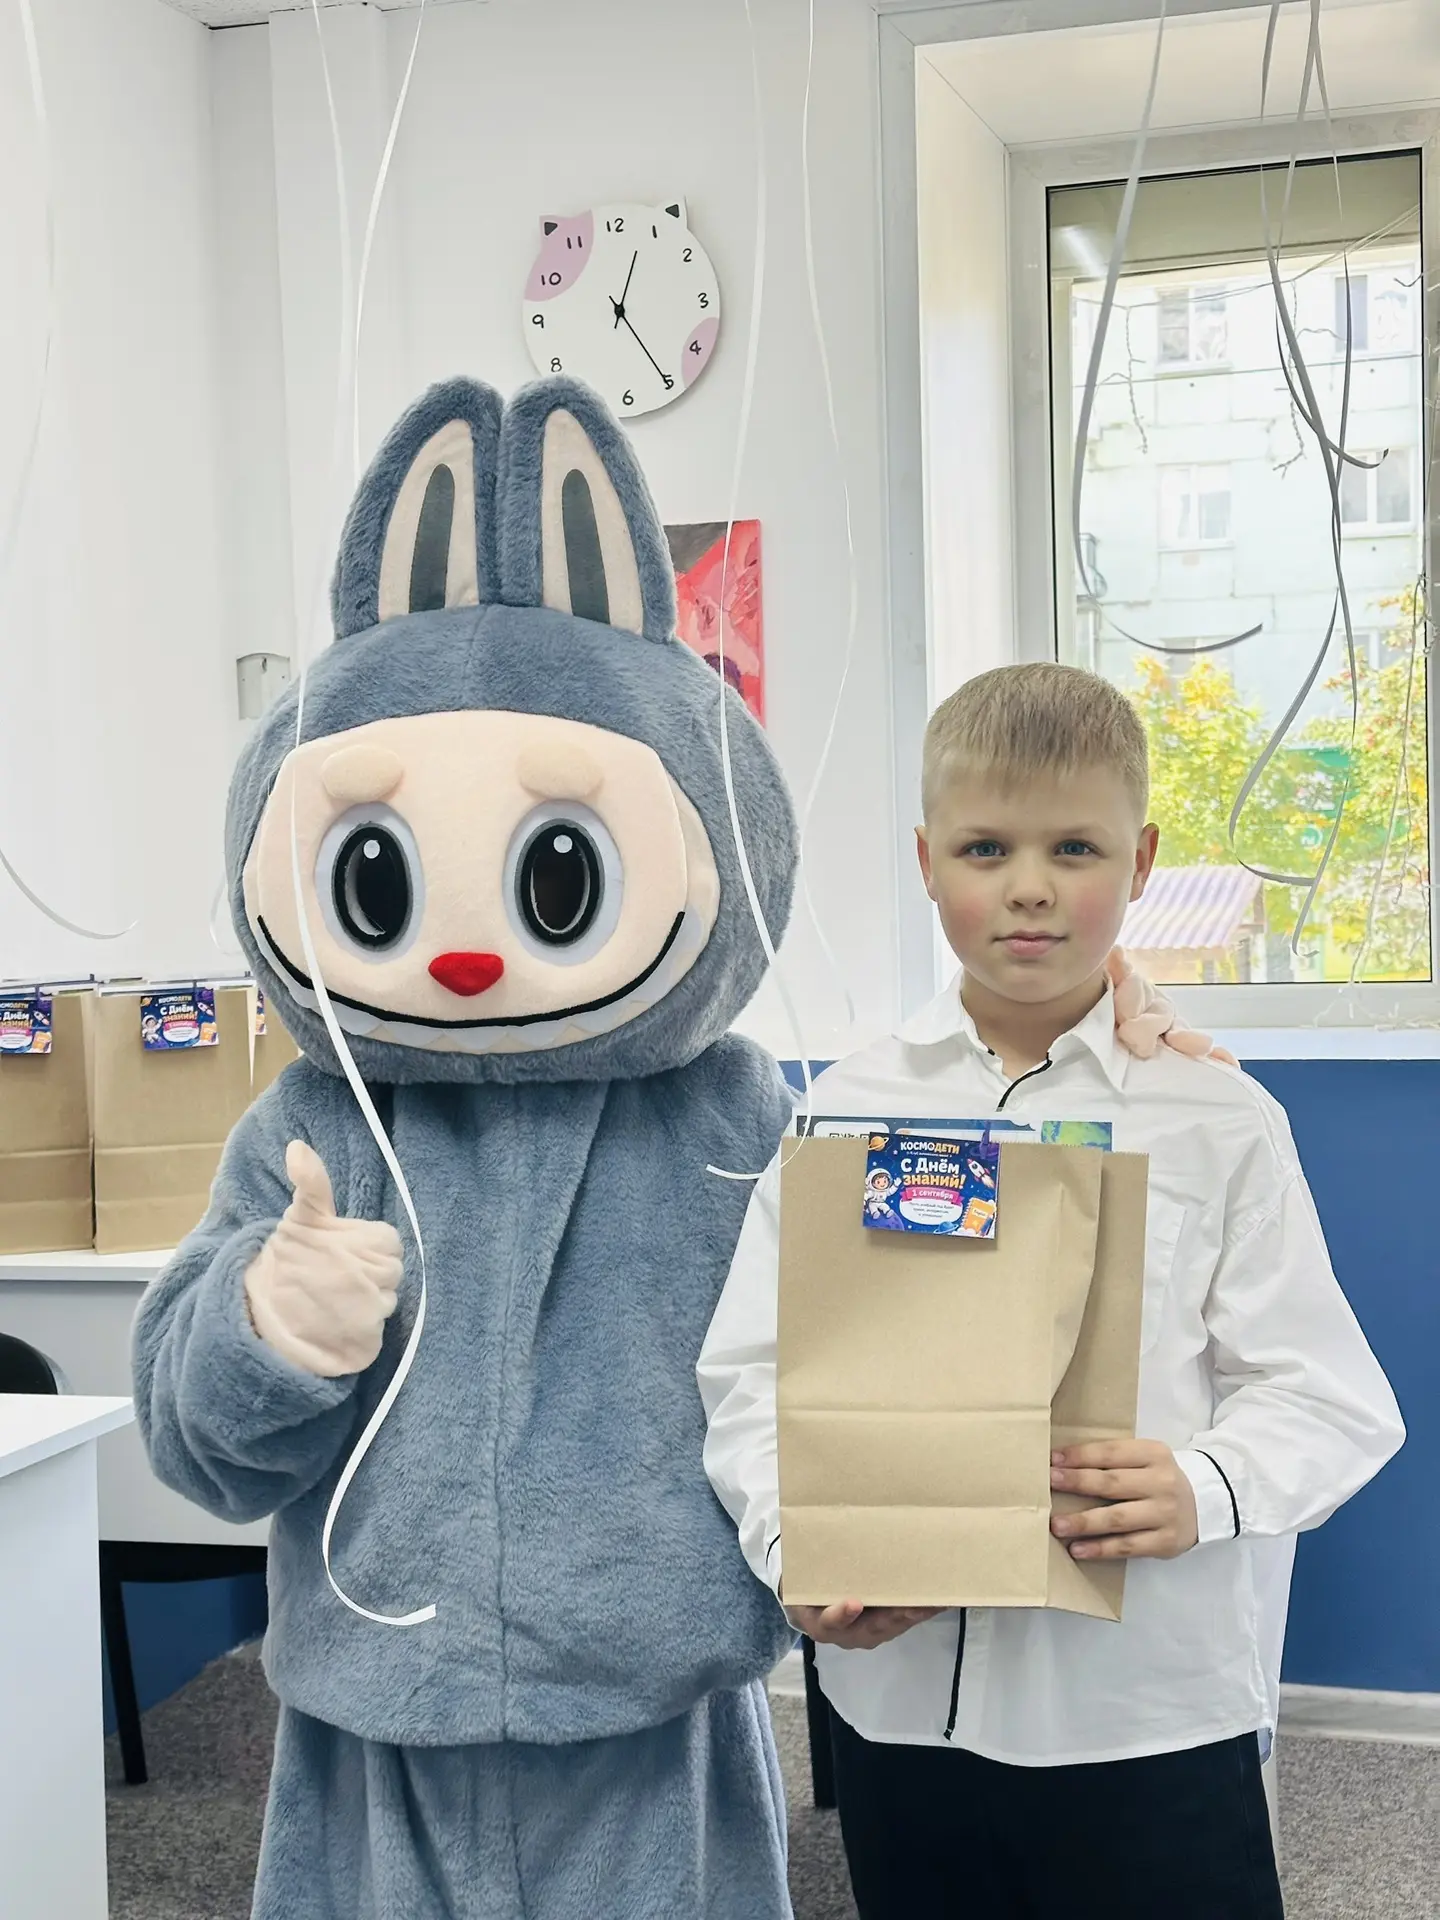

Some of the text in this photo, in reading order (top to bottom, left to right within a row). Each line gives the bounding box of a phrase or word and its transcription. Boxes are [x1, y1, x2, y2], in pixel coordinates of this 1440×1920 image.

[606, 218, 624, 232] 12
[652, 225, 658, 239] 1
[567, 236, 583, 249] 11
[682, 248, 692, 262] 2
[541, 272, 561, 285] 10
[698, 292, 709, 308] 3
[532, 314, 544, 328] 9
[689, 340, 702, 355] 4
[550, 357, 562, 372] 8
[664, 374, 675, 390] 5
[622, 389, 634, 405] 6
[160, 1004, 194, 1015] С Днём
[900, 1141, 960, 1154] КОСМОДЕТИ
[900, 1157, 960, 1174] С Днём
[903, 1174, 966, 1189] знаний!
[919, 1190, 954, 1200] сентября
